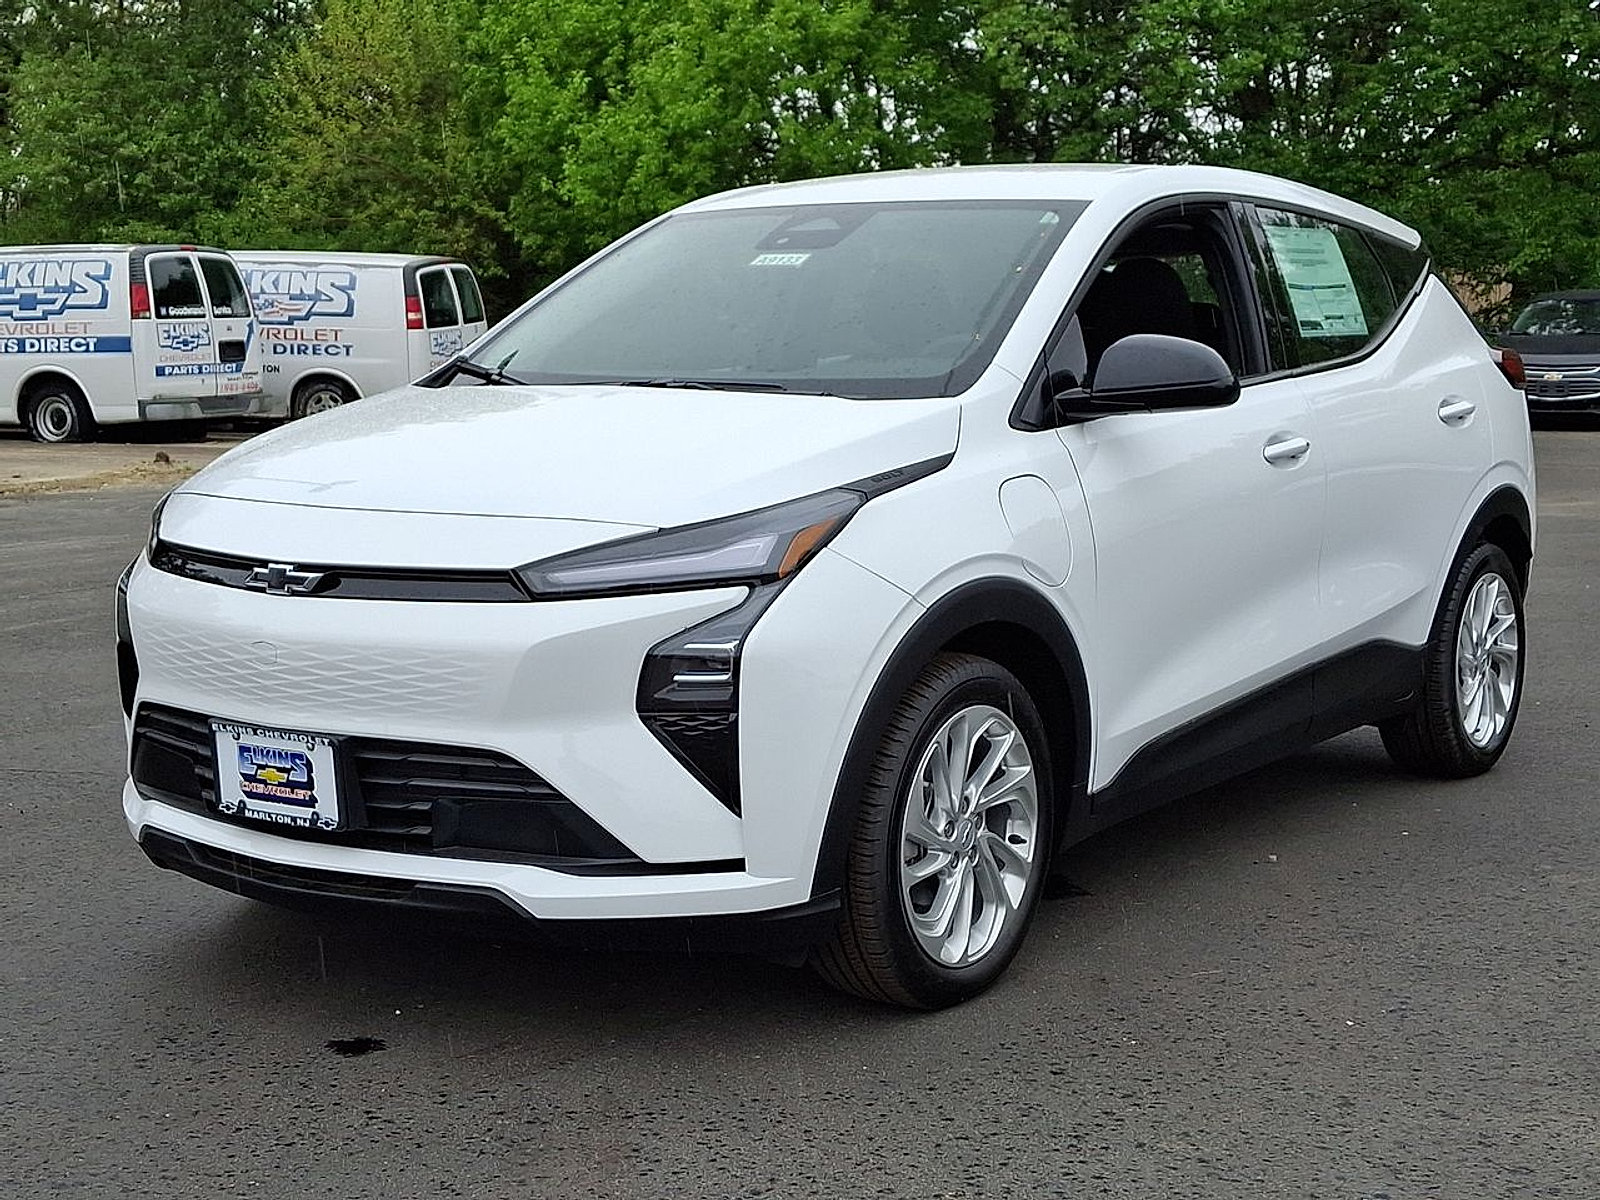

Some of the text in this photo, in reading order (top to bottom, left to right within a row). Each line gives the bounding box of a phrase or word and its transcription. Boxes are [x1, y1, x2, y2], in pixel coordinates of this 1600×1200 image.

[0, 261, 112, 309] KINS
[242, 270, 356, 317] KINS
[24, 337, 98, 352] DIRECT
[272, 343, 354, 356] DIRECT
[164, 362, 236, 375] PARTS DIRECT
[211, 723, 330, 746] ELKINS CHEVROLET
[237, 742, 309, 782] ELKINS
[241, 781, 312, 800] CHEVROLET
[245, 809, 311, 827] MARLTON, NJ
